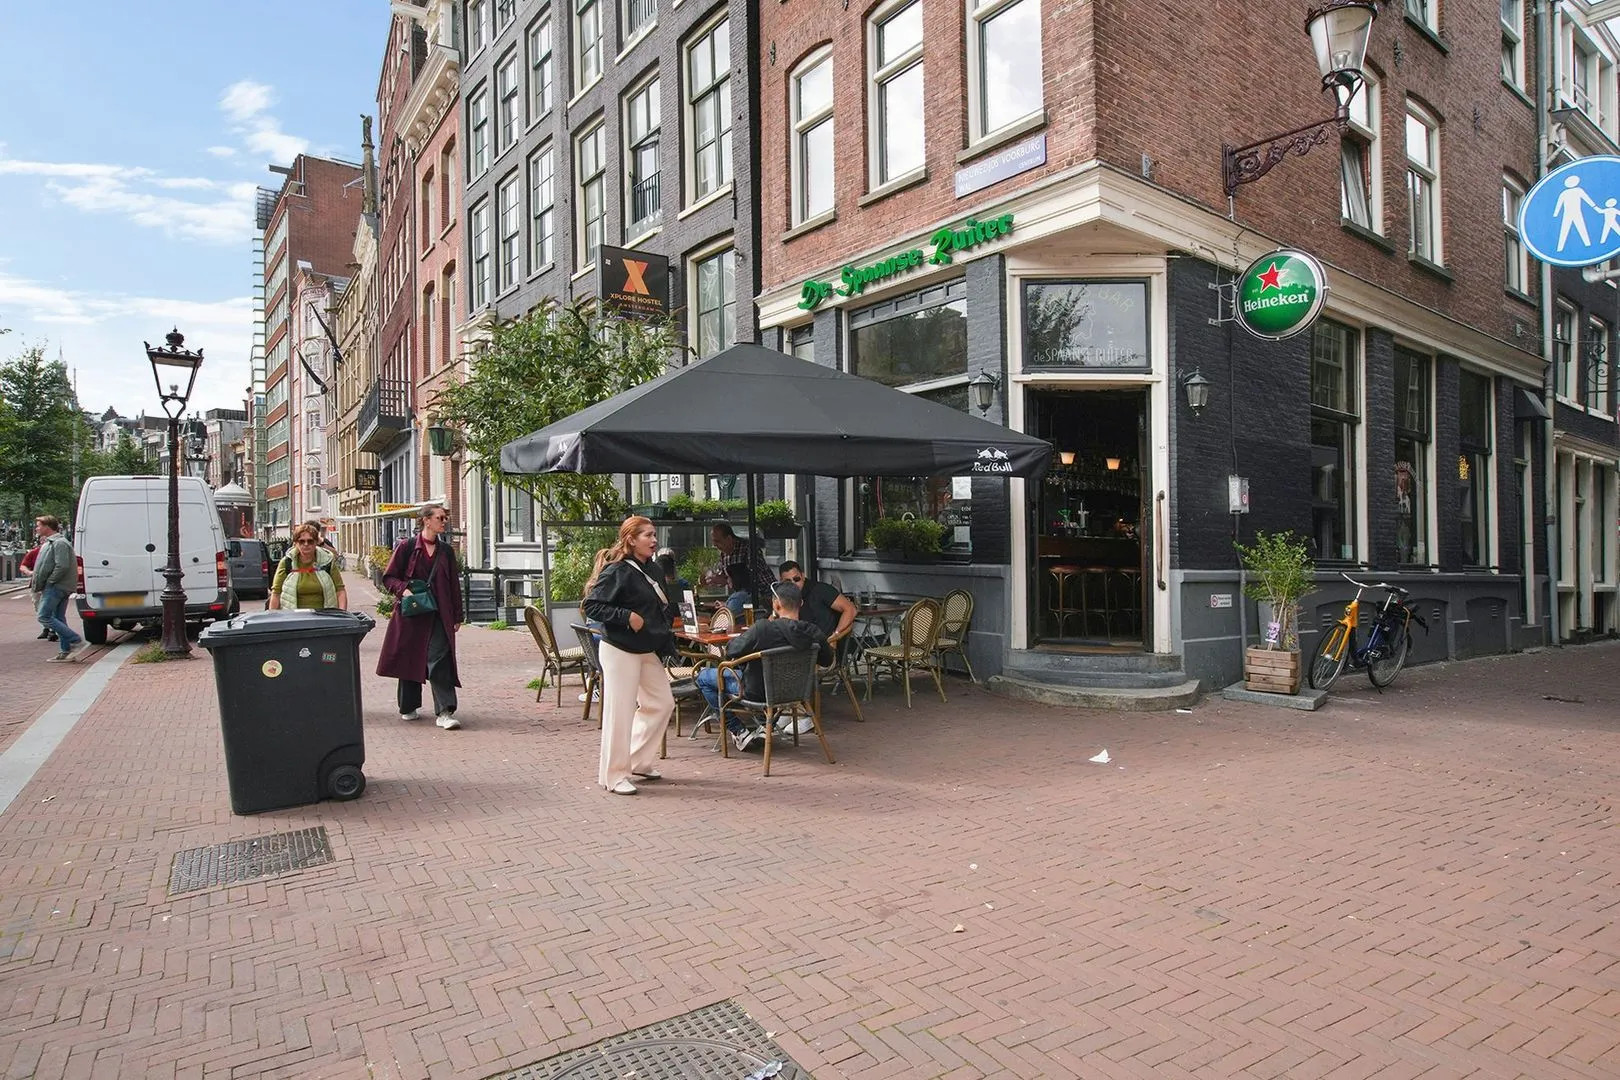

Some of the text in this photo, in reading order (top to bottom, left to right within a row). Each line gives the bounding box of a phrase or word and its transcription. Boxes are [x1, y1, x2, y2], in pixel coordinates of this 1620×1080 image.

[1001, 140, 1041, 164] VOORBURG
[797, 213, 1014, 311] De Spaanse Ruiter
[610, 293, 662, 306] XPLORE HOSTEL
[1243, 293, 1309, 313] Heineken
[671, 475, 680, 486] 92
